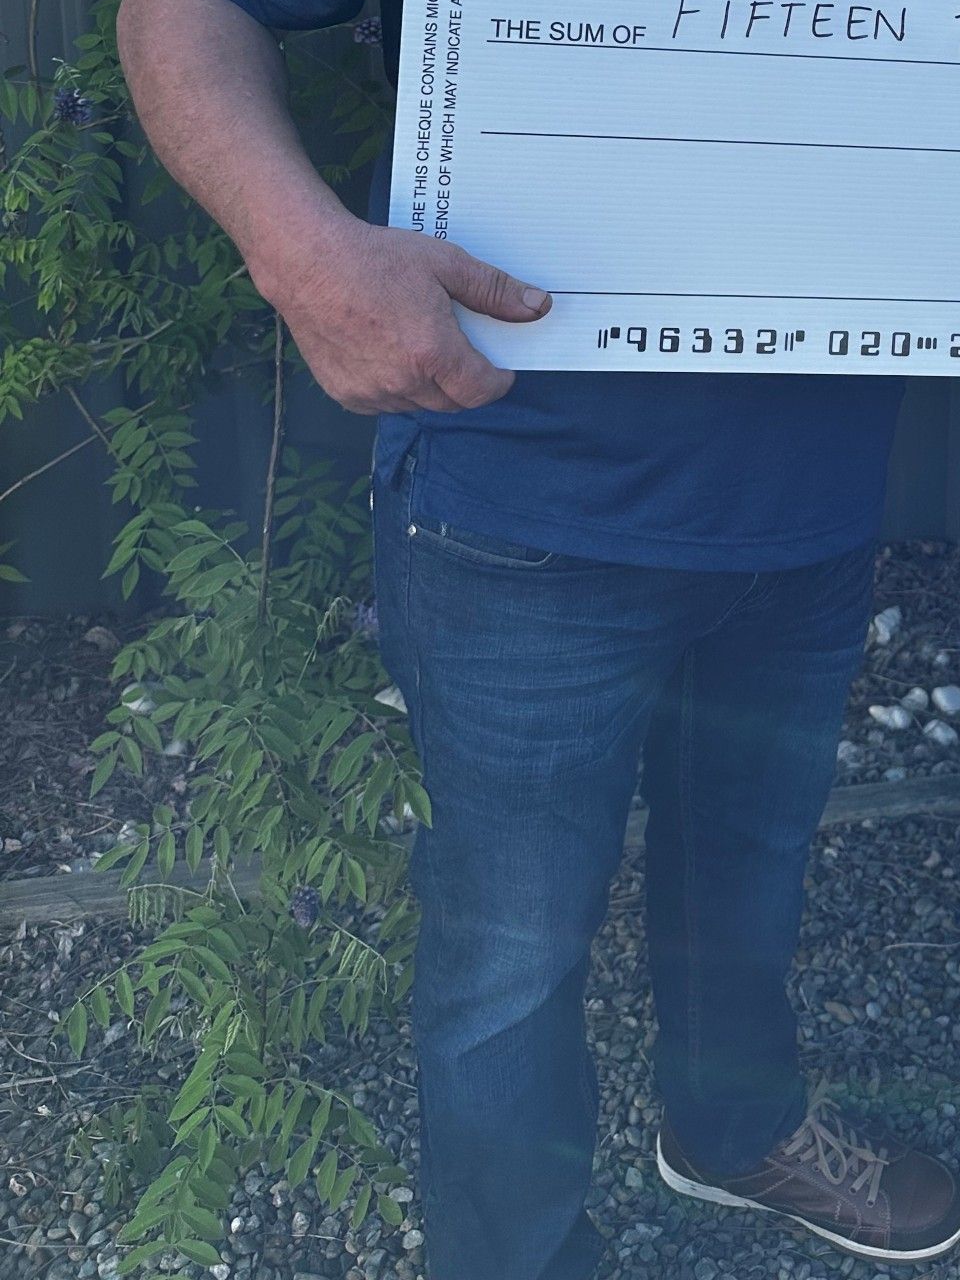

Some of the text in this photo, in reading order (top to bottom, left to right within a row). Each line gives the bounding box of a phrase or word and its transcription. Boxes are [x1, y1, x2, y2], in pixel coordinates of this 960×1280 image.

[447, 9, 462, 75] INDICATE
[491, 18, 647, 45] THE SUM OF
[421, 22, 438, 96] CONTAINS
[444, 79, 458, 110] MAY
[416, 99, 433, 162] CHEQUE
[440, 113, 456, 162] WHICH
[414, 164, 428, 199] THIS
[438, 165, 452, 186] OF
[411, 201, 426, 232] URE
[434, 190, 450, 240] SENCE
